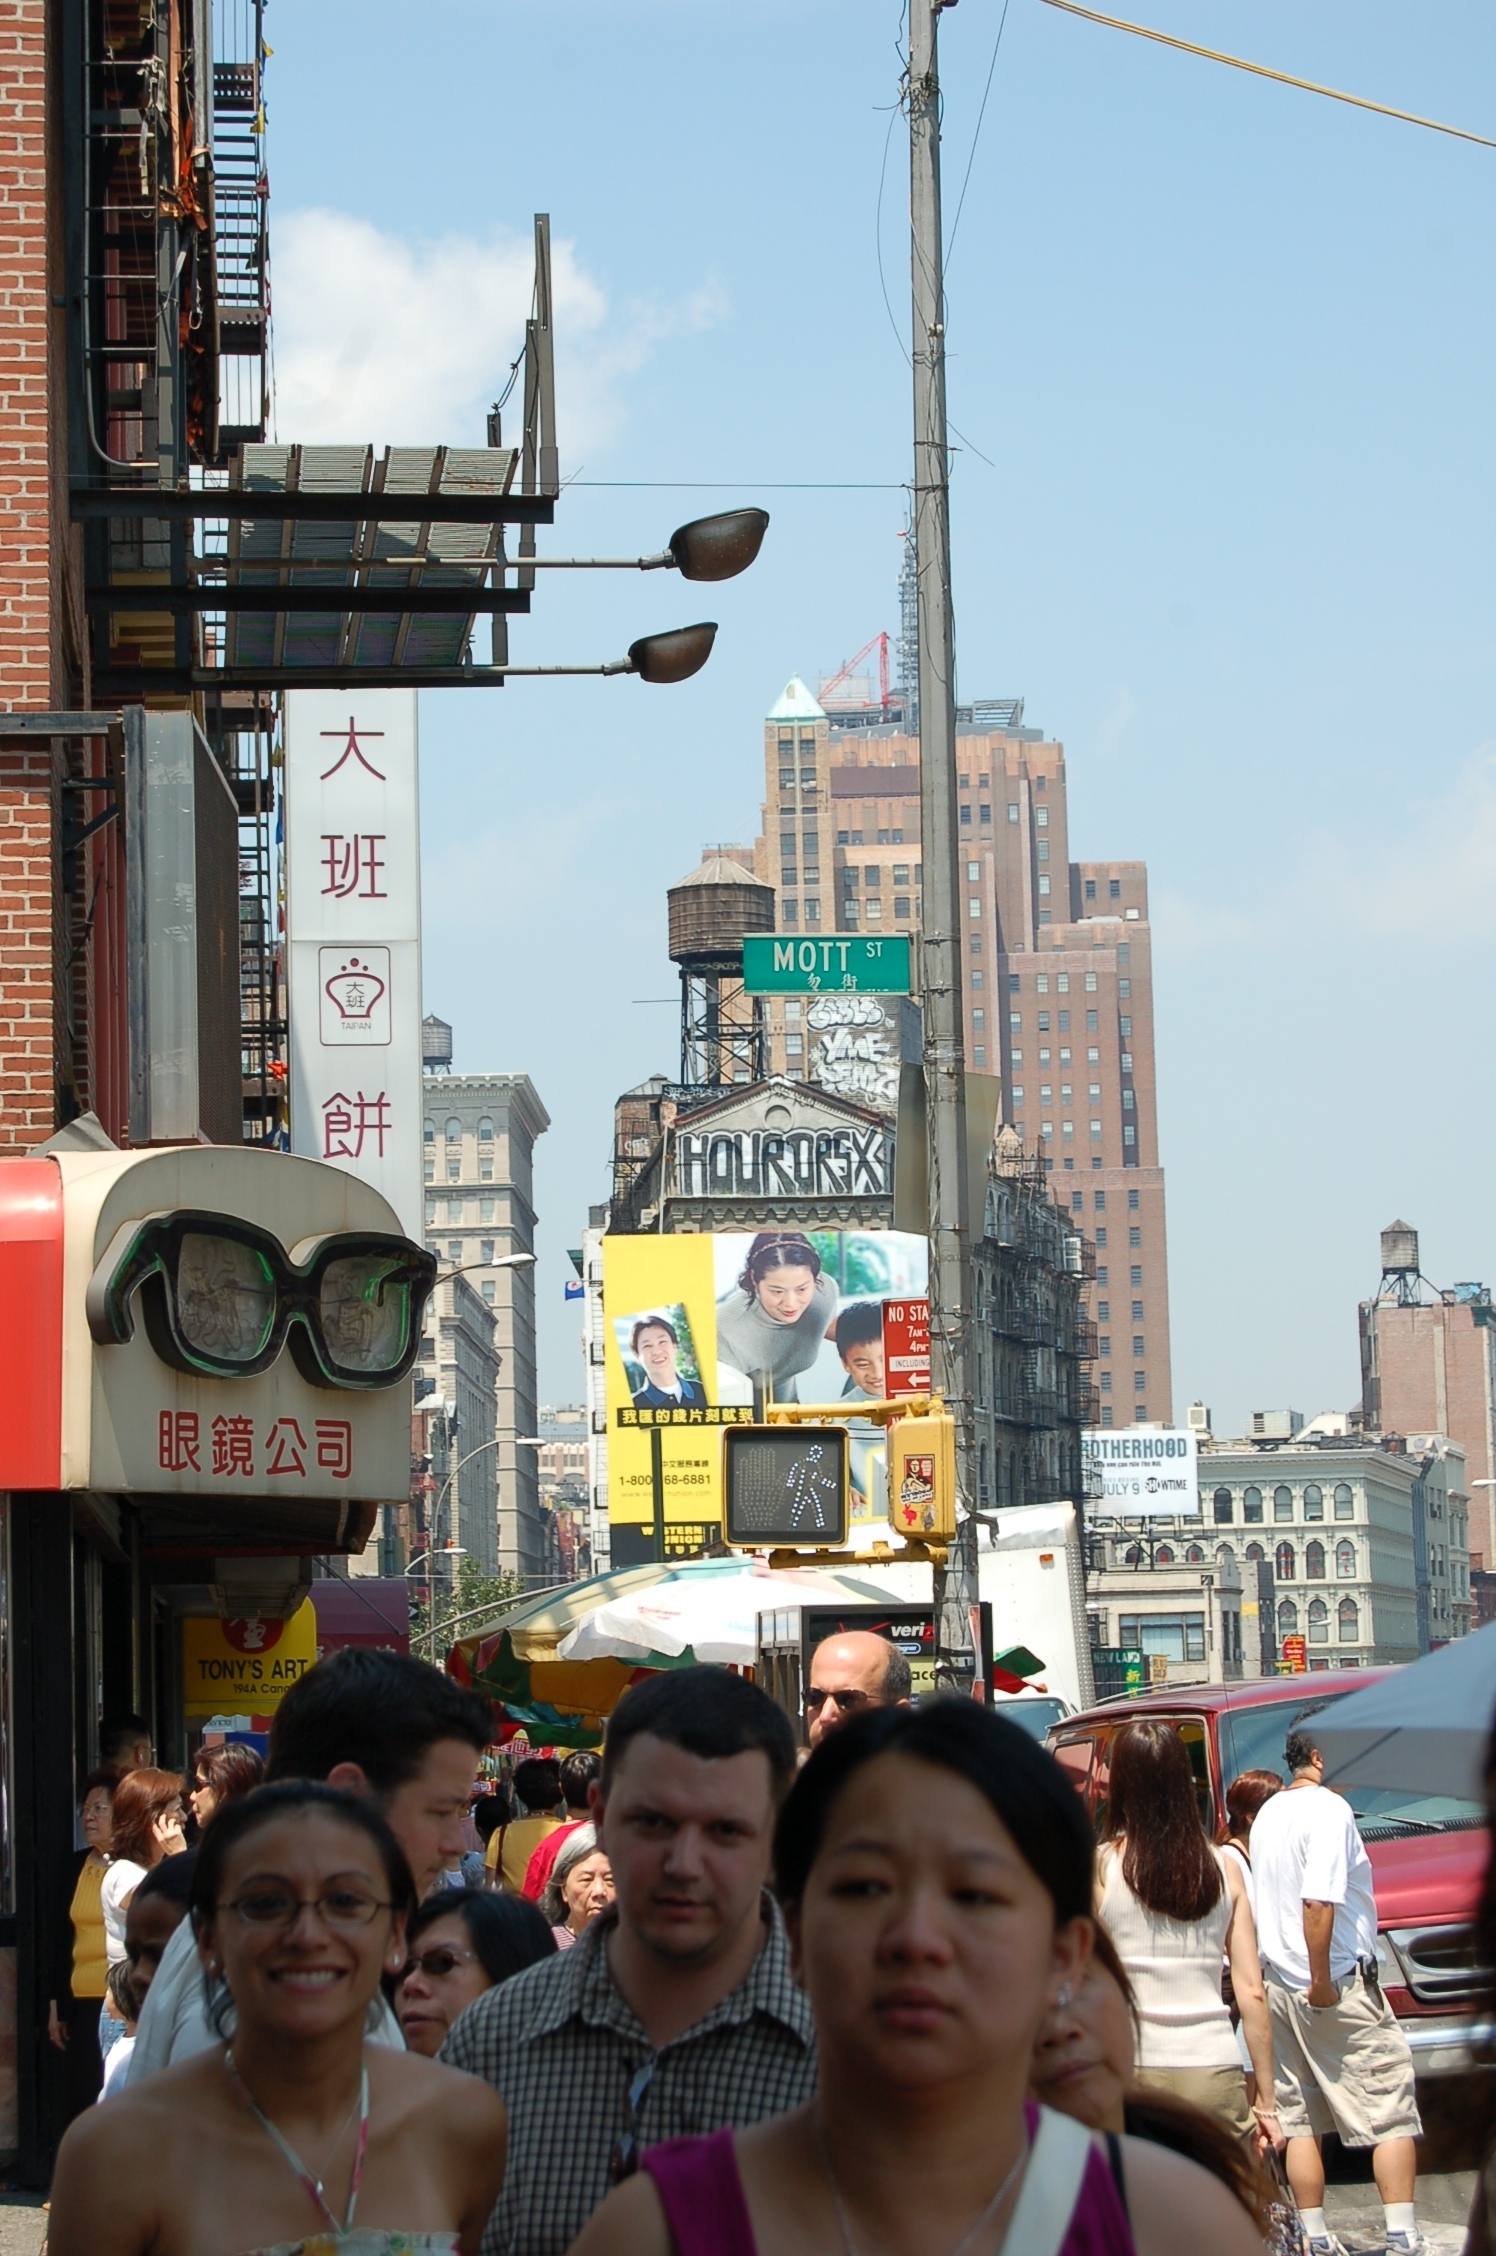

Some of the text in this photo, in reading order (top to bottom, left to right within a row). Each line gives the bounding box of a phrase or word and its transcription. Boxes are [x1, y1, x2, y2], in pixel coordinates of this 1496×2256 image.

[773, 941, 883, 972] MOTT ST
[345, 981, 365, 1008] 大班
[341, 1022, 371, 1030] TAIPAN
[889, 1307, 904, 1322] NO
[159, 1410, 351, 1479] 眼鏡公司
[1132, 1482, 1140, 1495] 9
[1145, 1477, 1188, 1493] SHOWTIME
[198, 1659, 308, 1680] TONY'S ART
[233, 1683, 258, 1694] 194A
